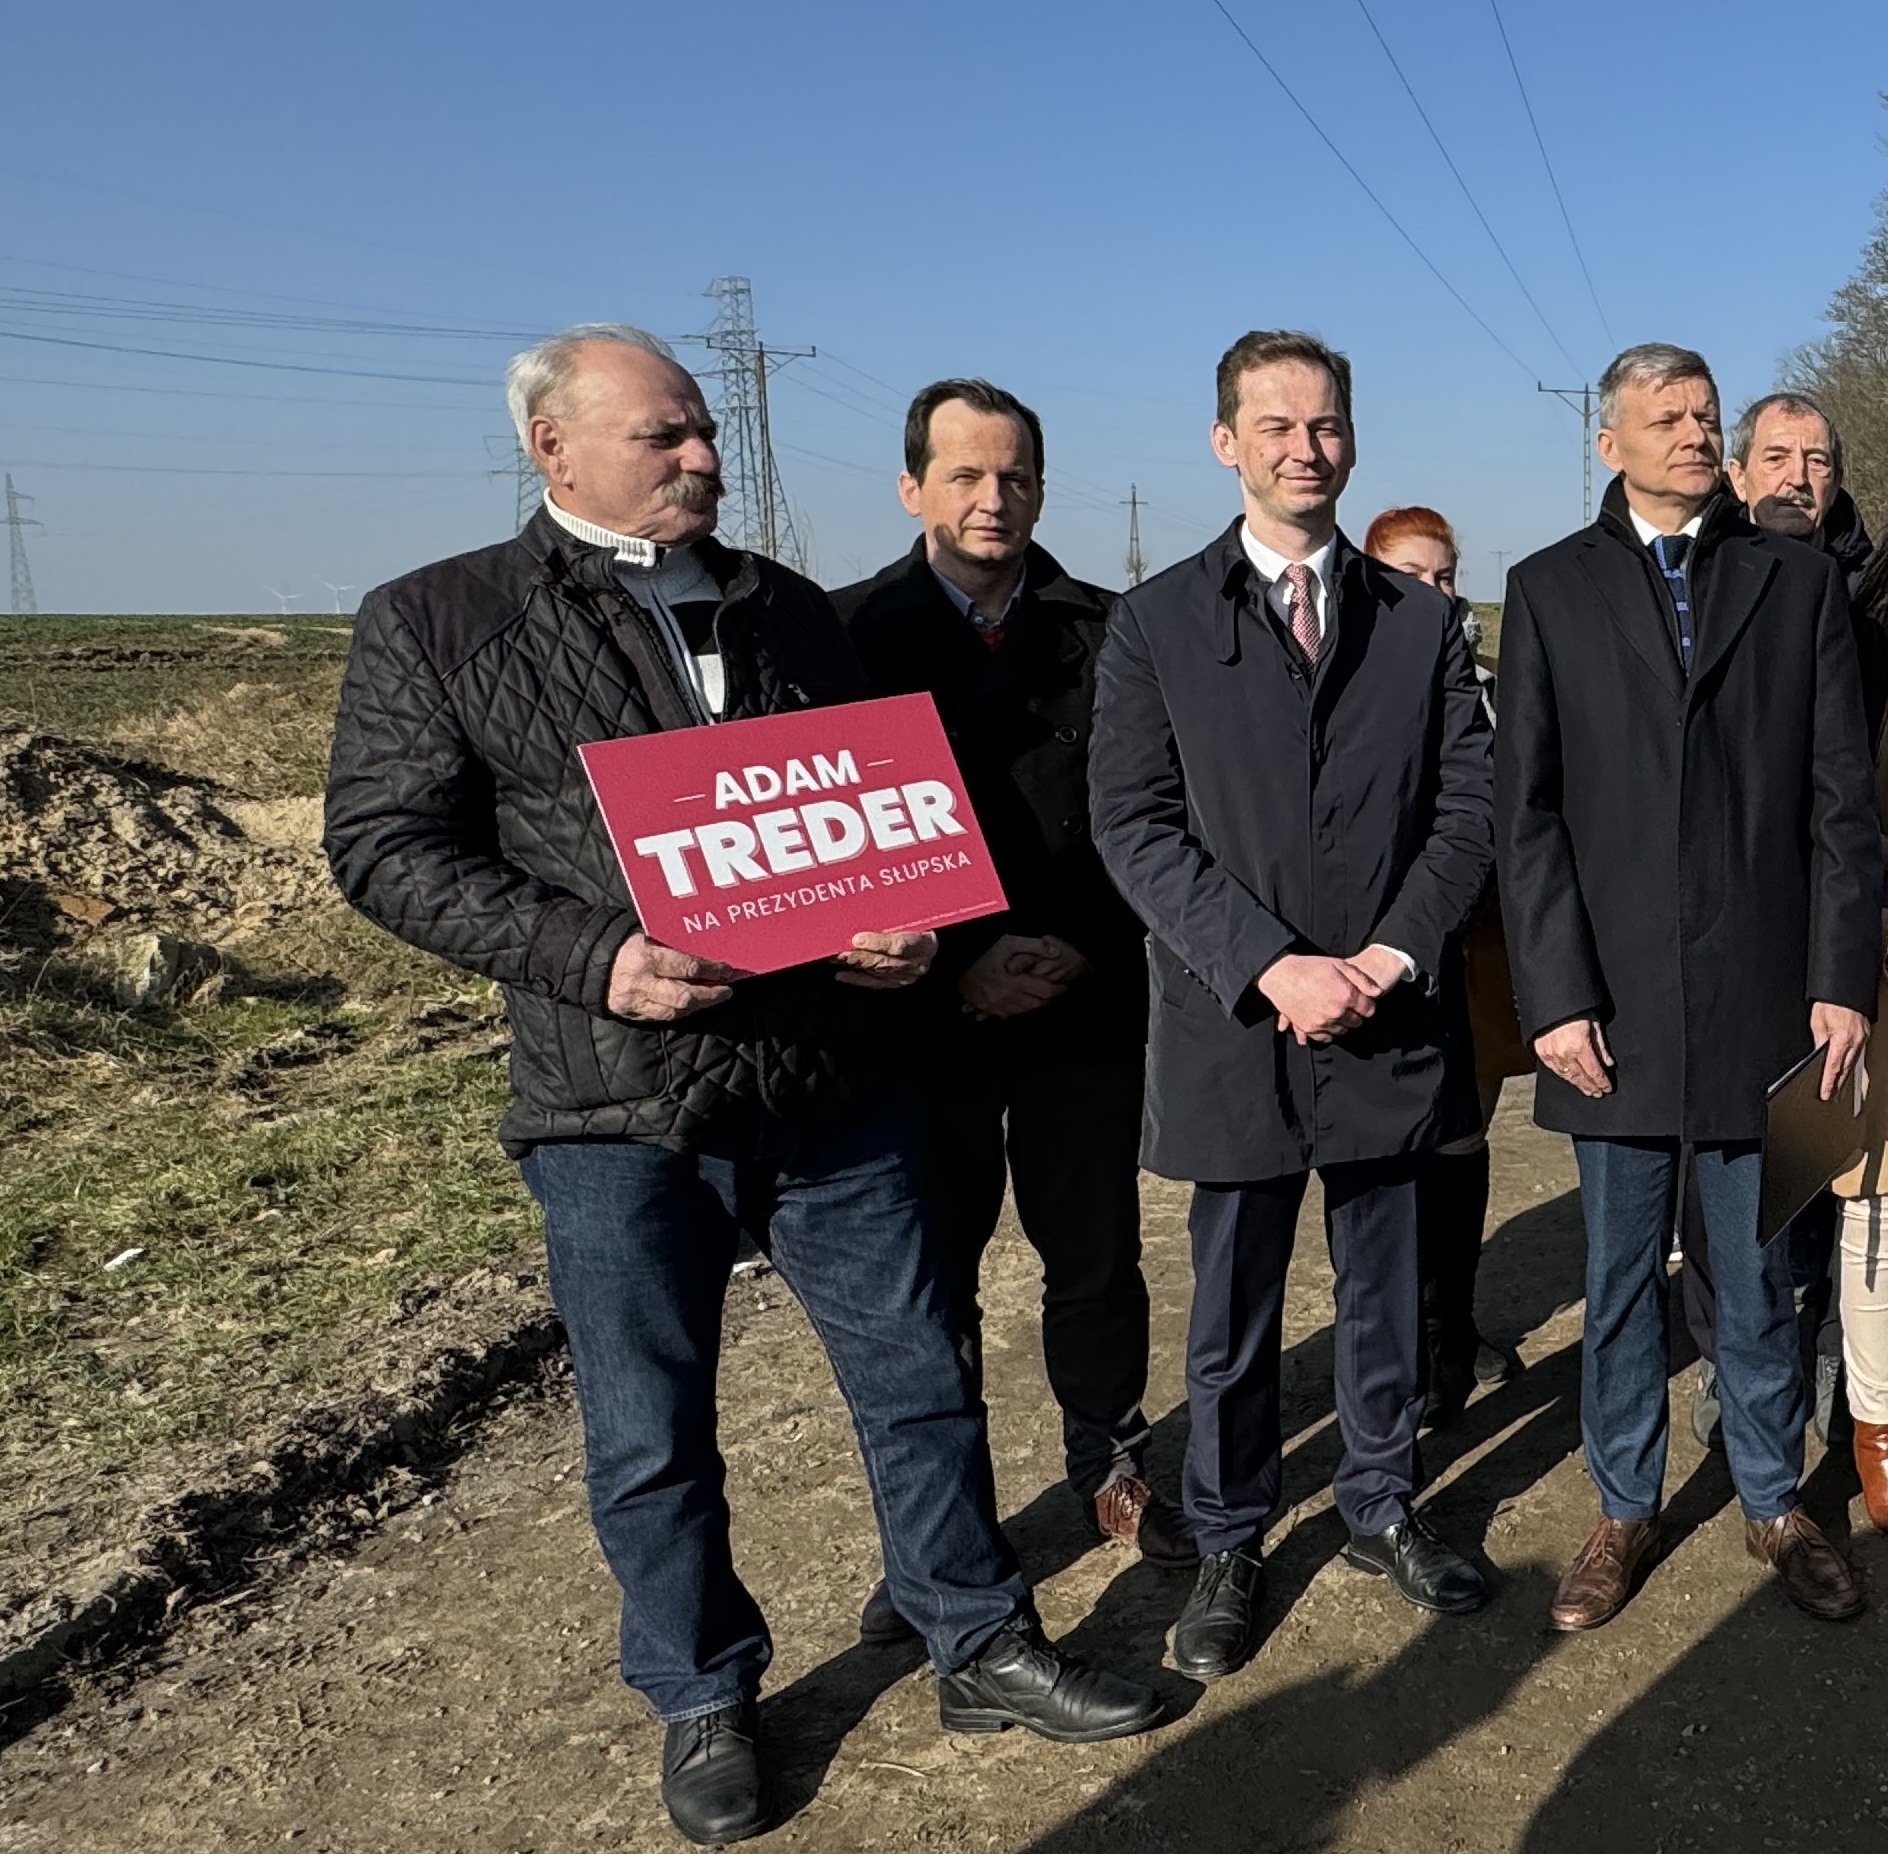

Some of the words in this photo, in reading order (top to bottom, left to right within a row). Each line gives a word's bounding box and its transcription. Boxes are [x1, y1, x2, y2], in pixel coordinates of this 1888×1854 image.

[715, 749, 861, 810] ADAM
[634, 780, 968, 899] TREDER
[682, 908, 721, 934] NA
[729, 873, 875, 924] PREZYDENTA
[879, 850, 972, 887] SŁUPSKA
